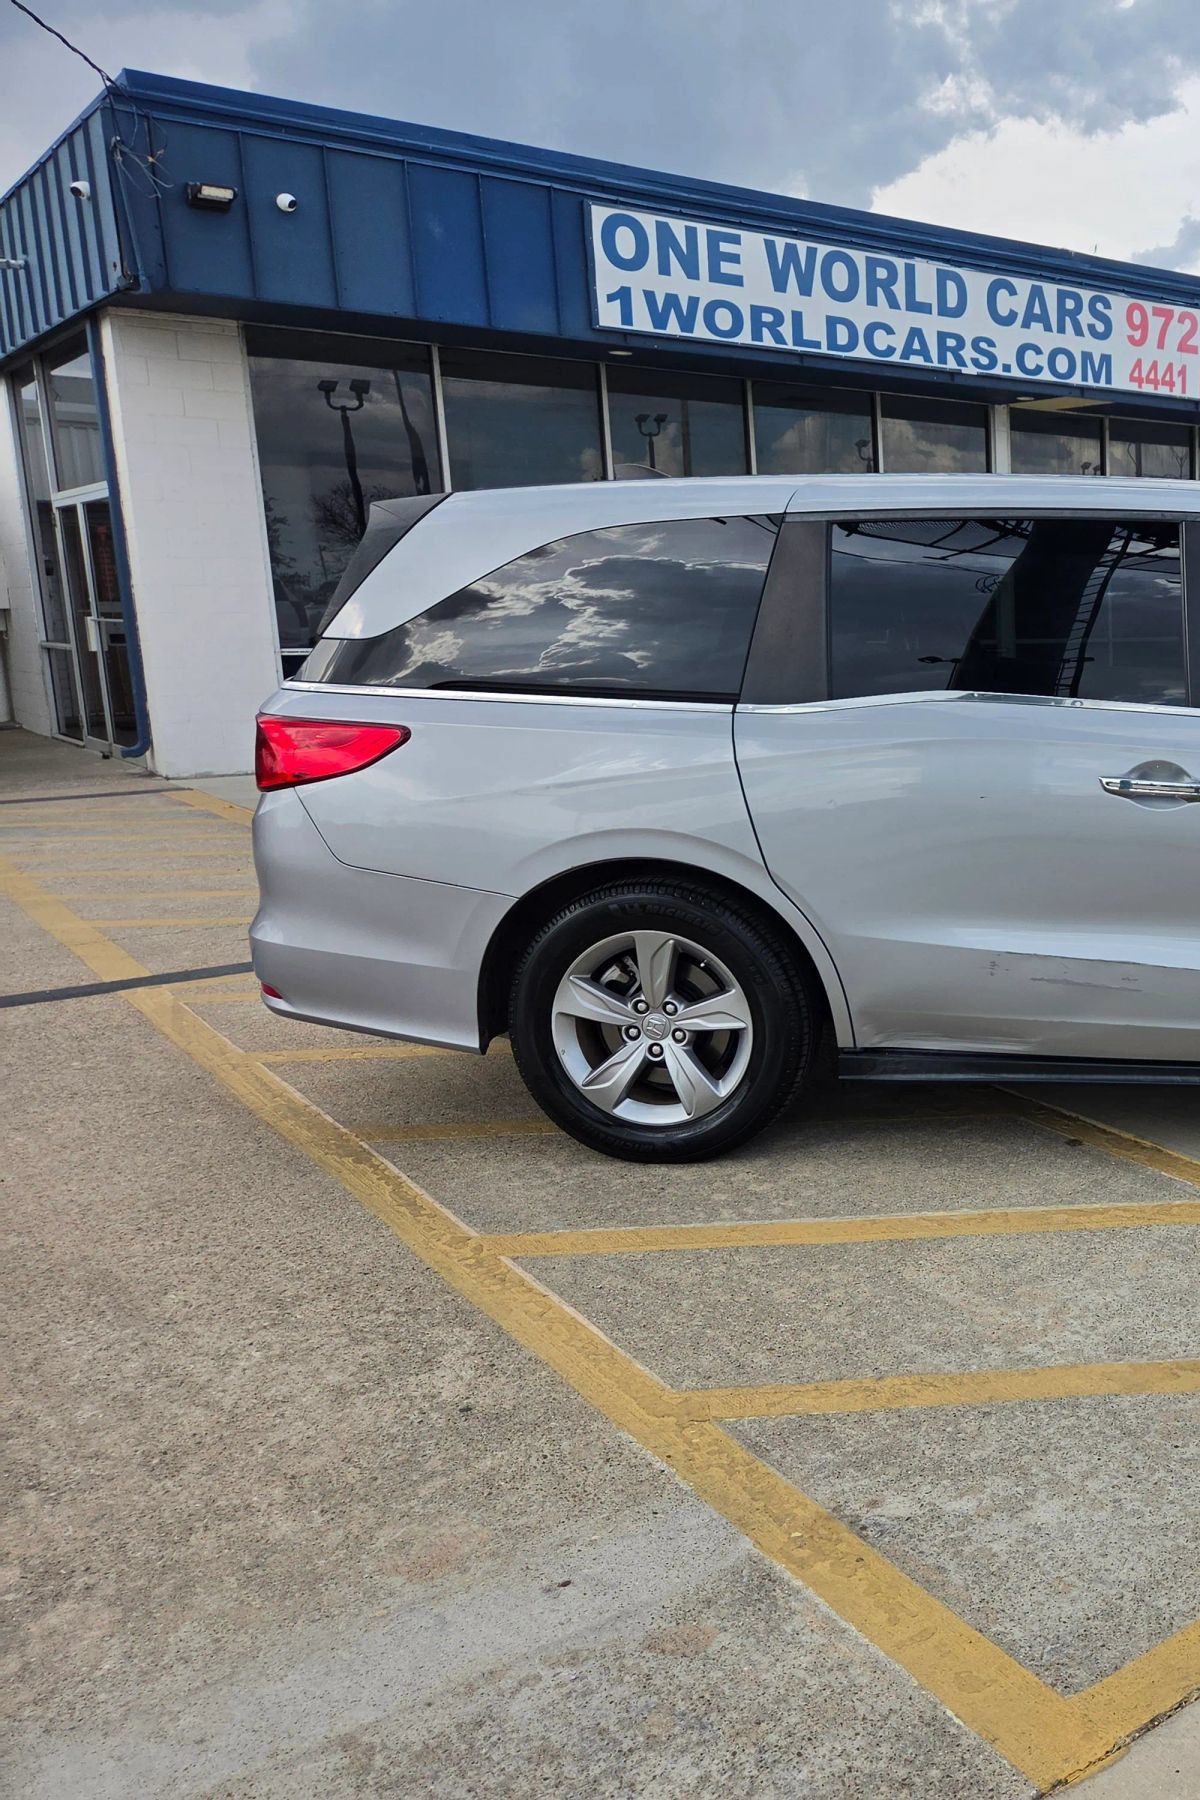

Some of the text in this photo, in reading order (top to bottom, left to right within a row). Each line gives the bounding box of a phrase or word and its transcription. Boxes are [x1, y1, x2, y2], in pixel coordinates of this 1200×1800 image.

[599, 211, 1114, 343] ONE WORLD CARS
[606, 284, 1114, 387] 1WORLDCARS.COM
[1128, 359, 1188, 395] 4441
